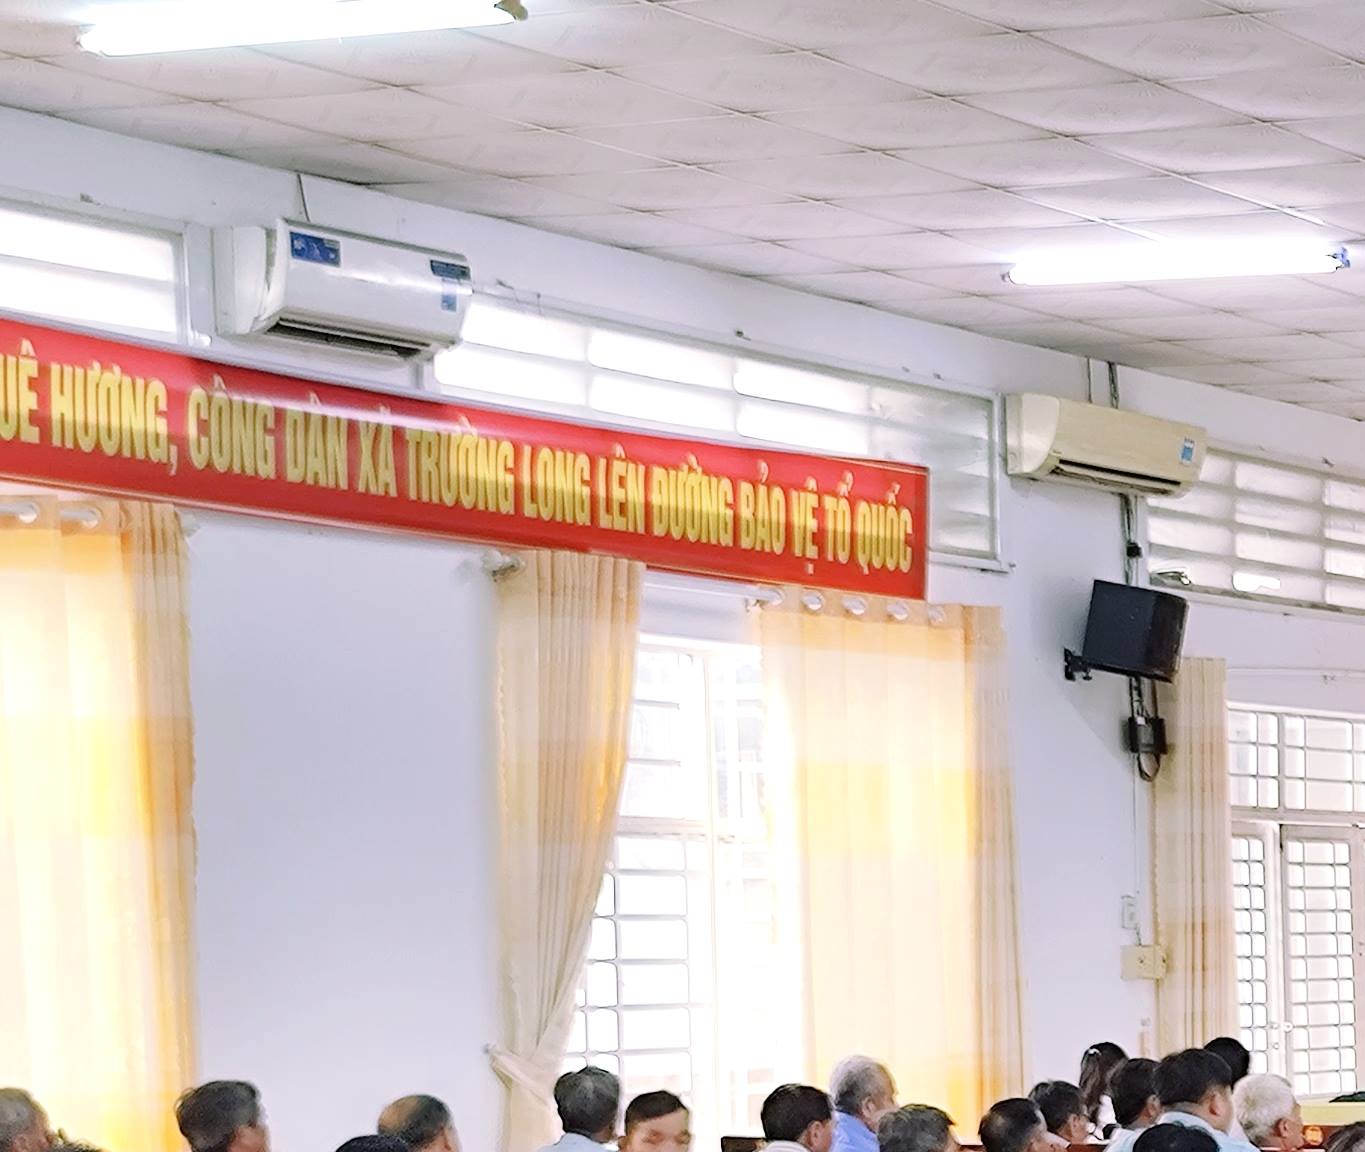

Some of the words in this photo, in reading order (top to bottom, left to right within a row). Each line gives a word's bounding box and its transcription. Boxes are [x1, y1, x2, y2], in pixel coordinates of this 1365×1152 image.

[0, 337, 40, 444] UÊ
[50, 359, 178, 476] HƯƠNG,
[188, 373, 276, 480] CÔNG
[285, 391, 348, 490] DÂN
[405, 414, 515, 515] TRƯỜNG
[523, 443, 591, 527] LONG
[598, 442, 646, 535] LÊN
[651, 451, 734, 547] ĐƯỜNG
[739, 459, 786, 555] BẢO
[790, 475, 819, 576] VỆ
[823, 470, 854, 564] TỔ
[856, 481, 914, 575] QUỐC
